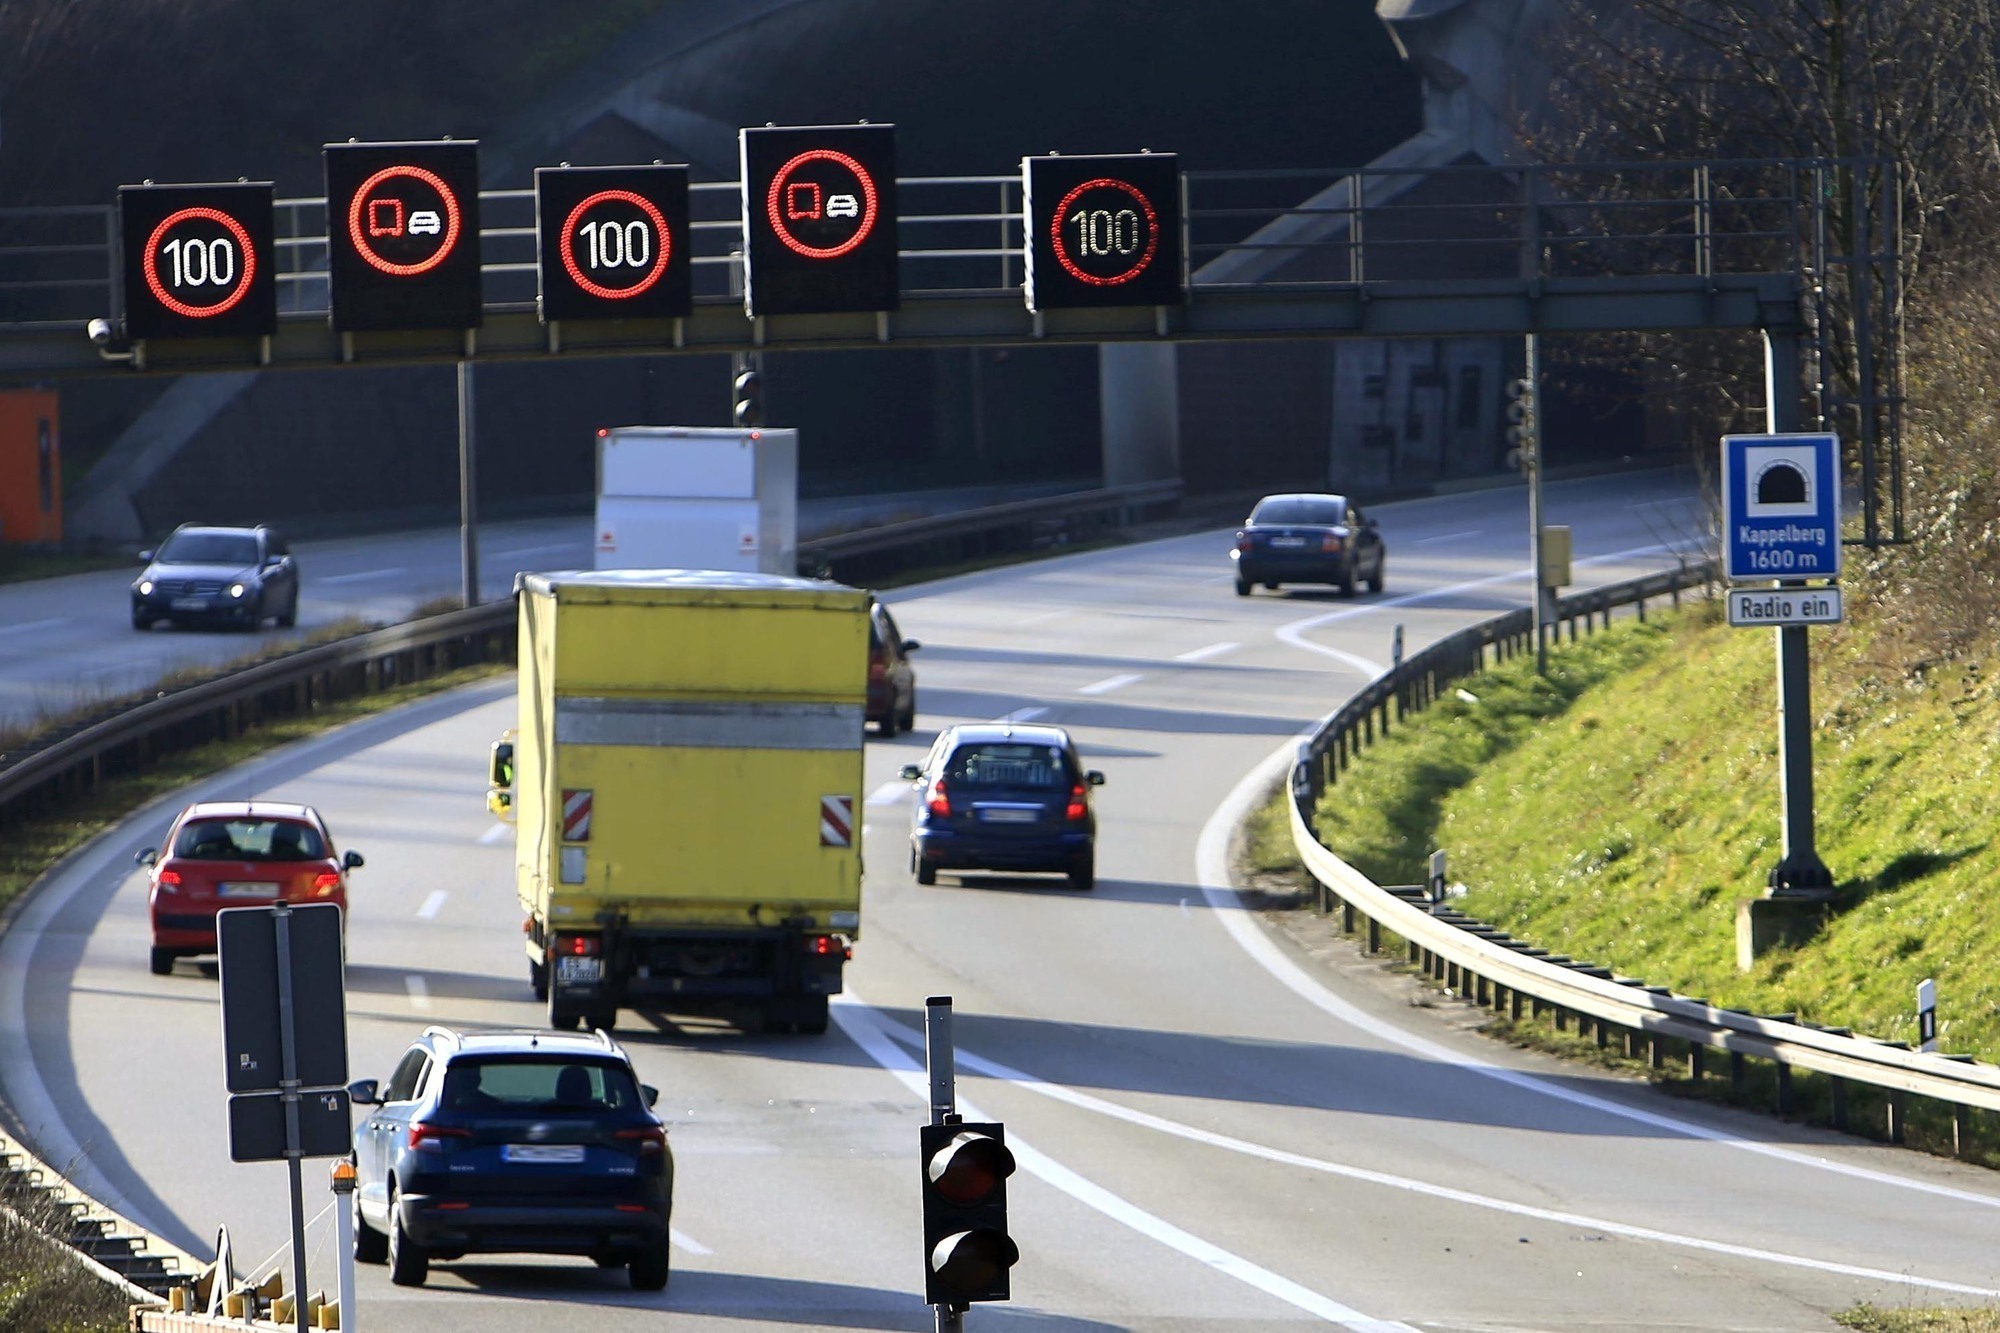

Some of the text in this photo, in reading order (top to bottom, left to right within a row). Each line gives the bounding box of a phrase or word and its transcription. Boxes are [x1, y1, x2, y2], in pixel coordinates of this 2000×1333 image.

[580, 221, 650, 269] 100
[1070, 209, 1138, 256] 100
[163, 238, 234, 287] 100
[1739, 525, 1825, 546] Kappelberg
[1749, 550, 1817, 568] 1600 m
[1741, 595, 1829, 618] Radio ein
